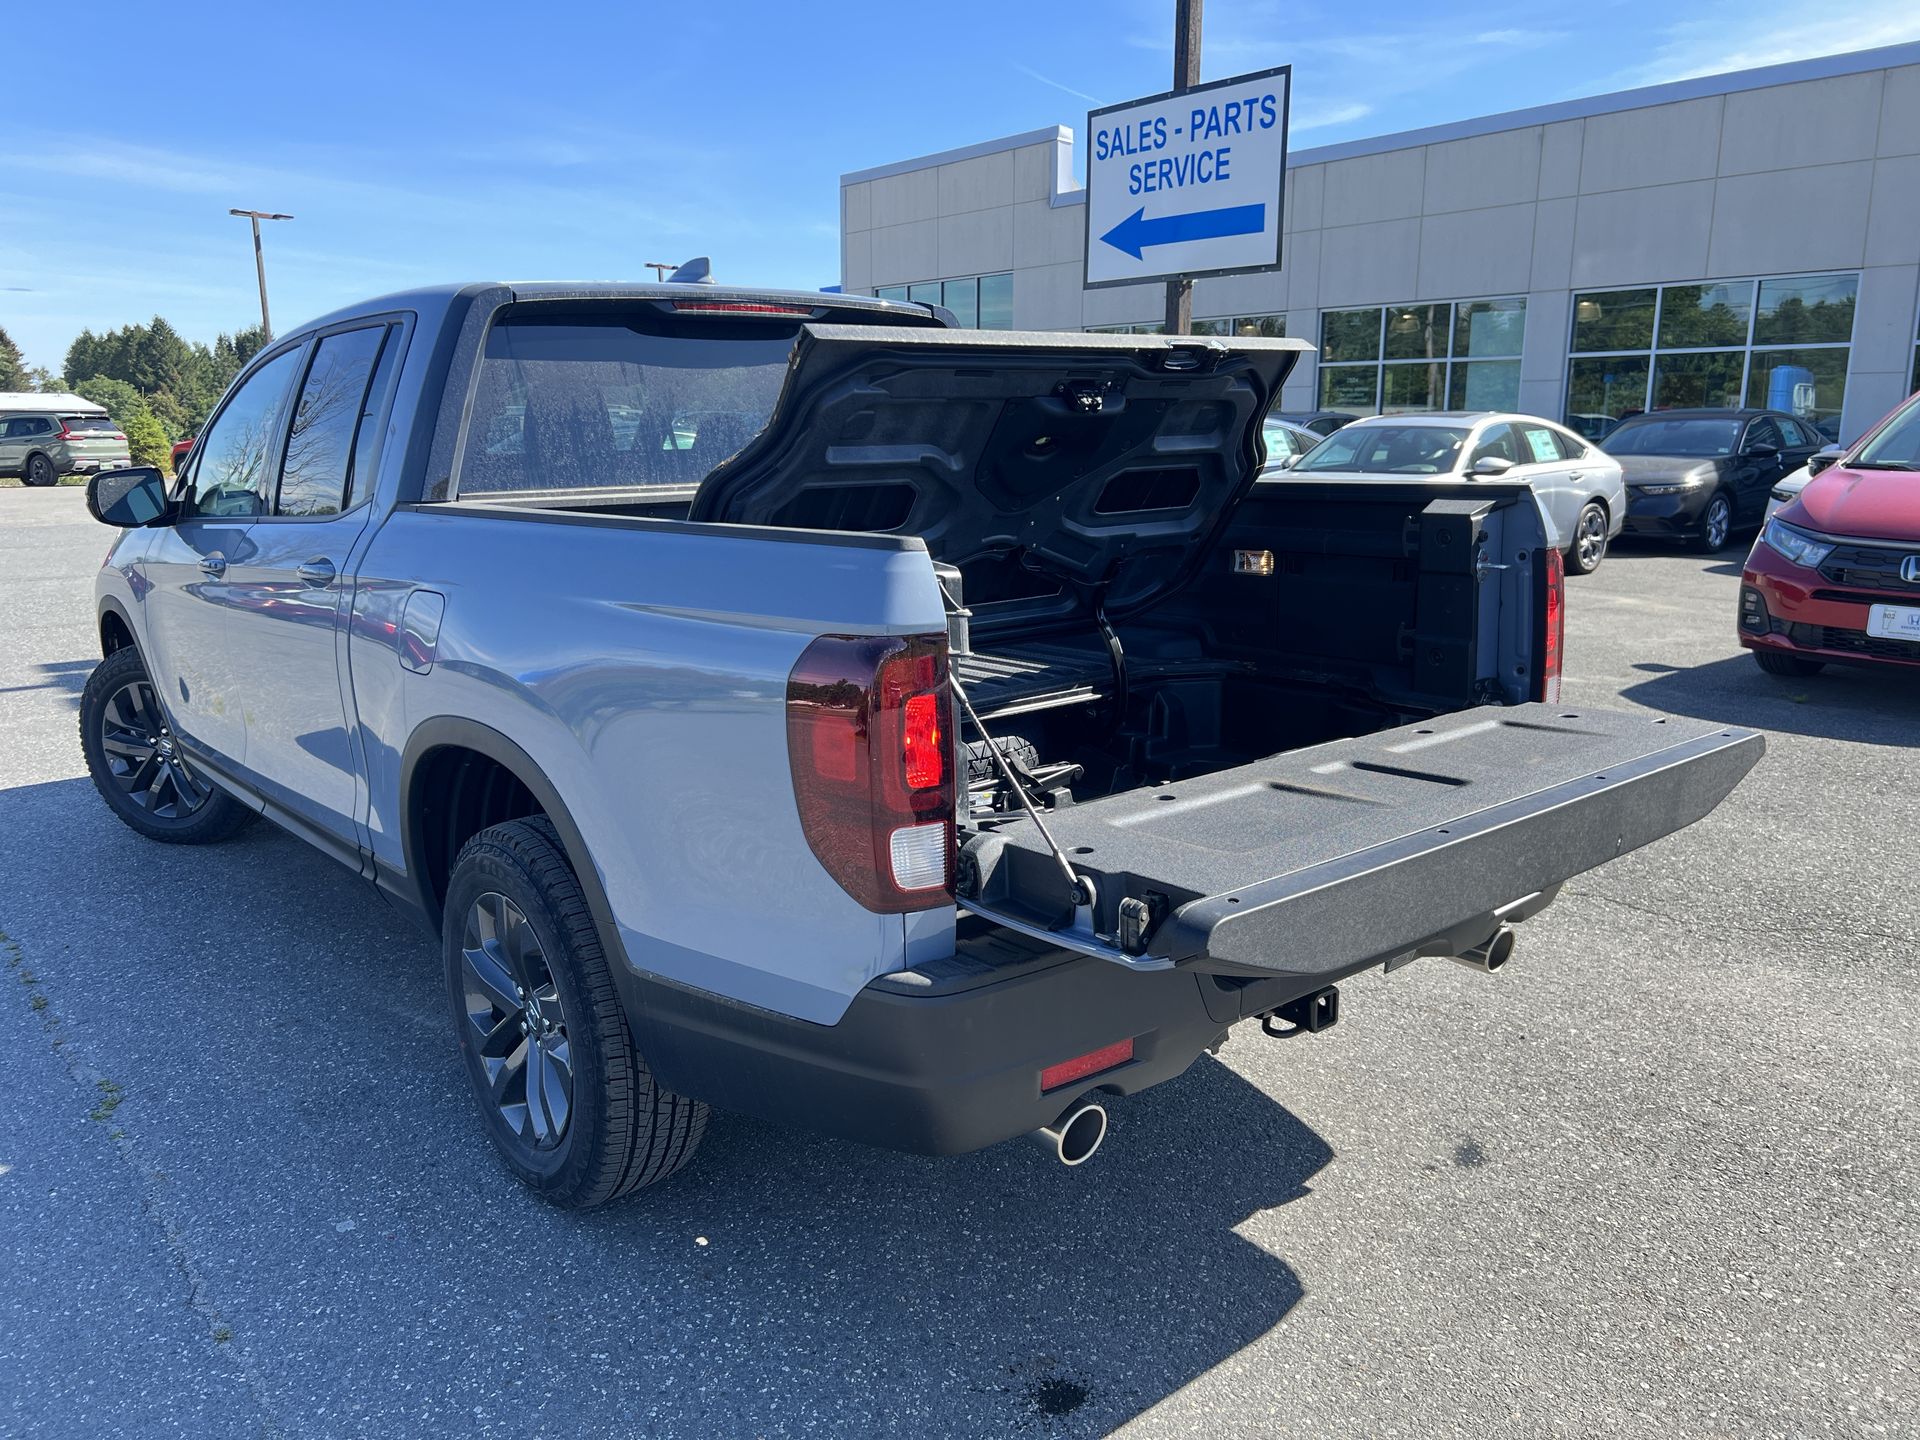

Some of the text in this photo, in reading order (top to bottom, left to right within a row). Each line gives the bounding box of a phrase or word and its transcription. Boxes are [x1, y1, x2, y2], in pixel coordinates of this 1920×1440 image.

[1096, 116, 1167, 161] SALES
[1190, 94, 1277, 142] PARTS
[1129, 147, 1231, 195] SERVICE
